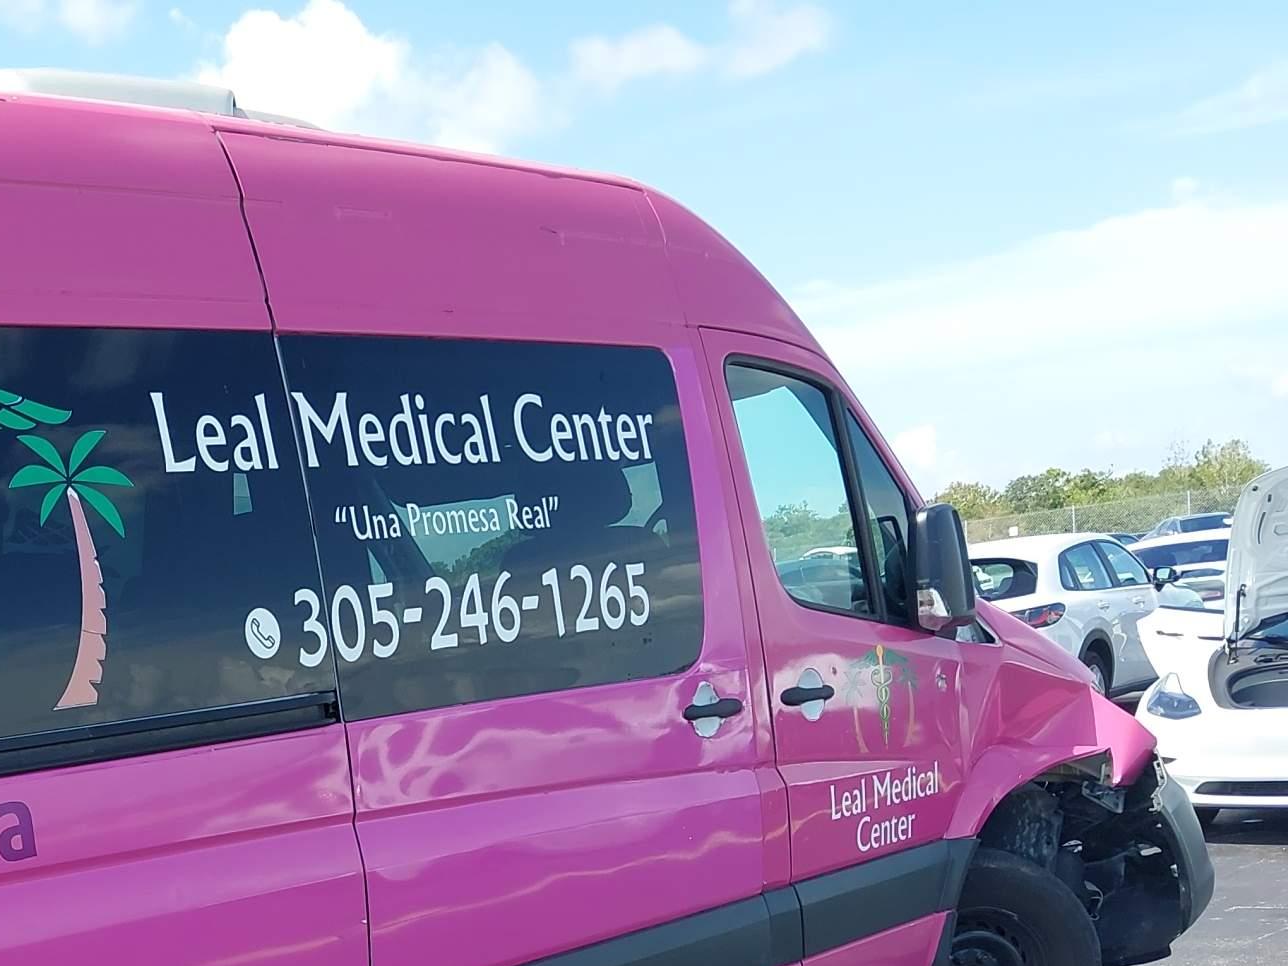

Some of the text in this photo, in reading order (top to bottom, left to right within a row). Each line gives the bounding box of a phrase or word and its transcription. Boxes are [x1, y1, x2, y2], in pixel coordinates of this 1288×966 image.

[149, 392, 654, 473] Leal Medical Center
[407, 498, 501, 537] Promesa
[293, 562, 650, 668] 305-246-1265
[830, 760, 939, 820] Leal Medical
[856, 813, 916, 852] Center
